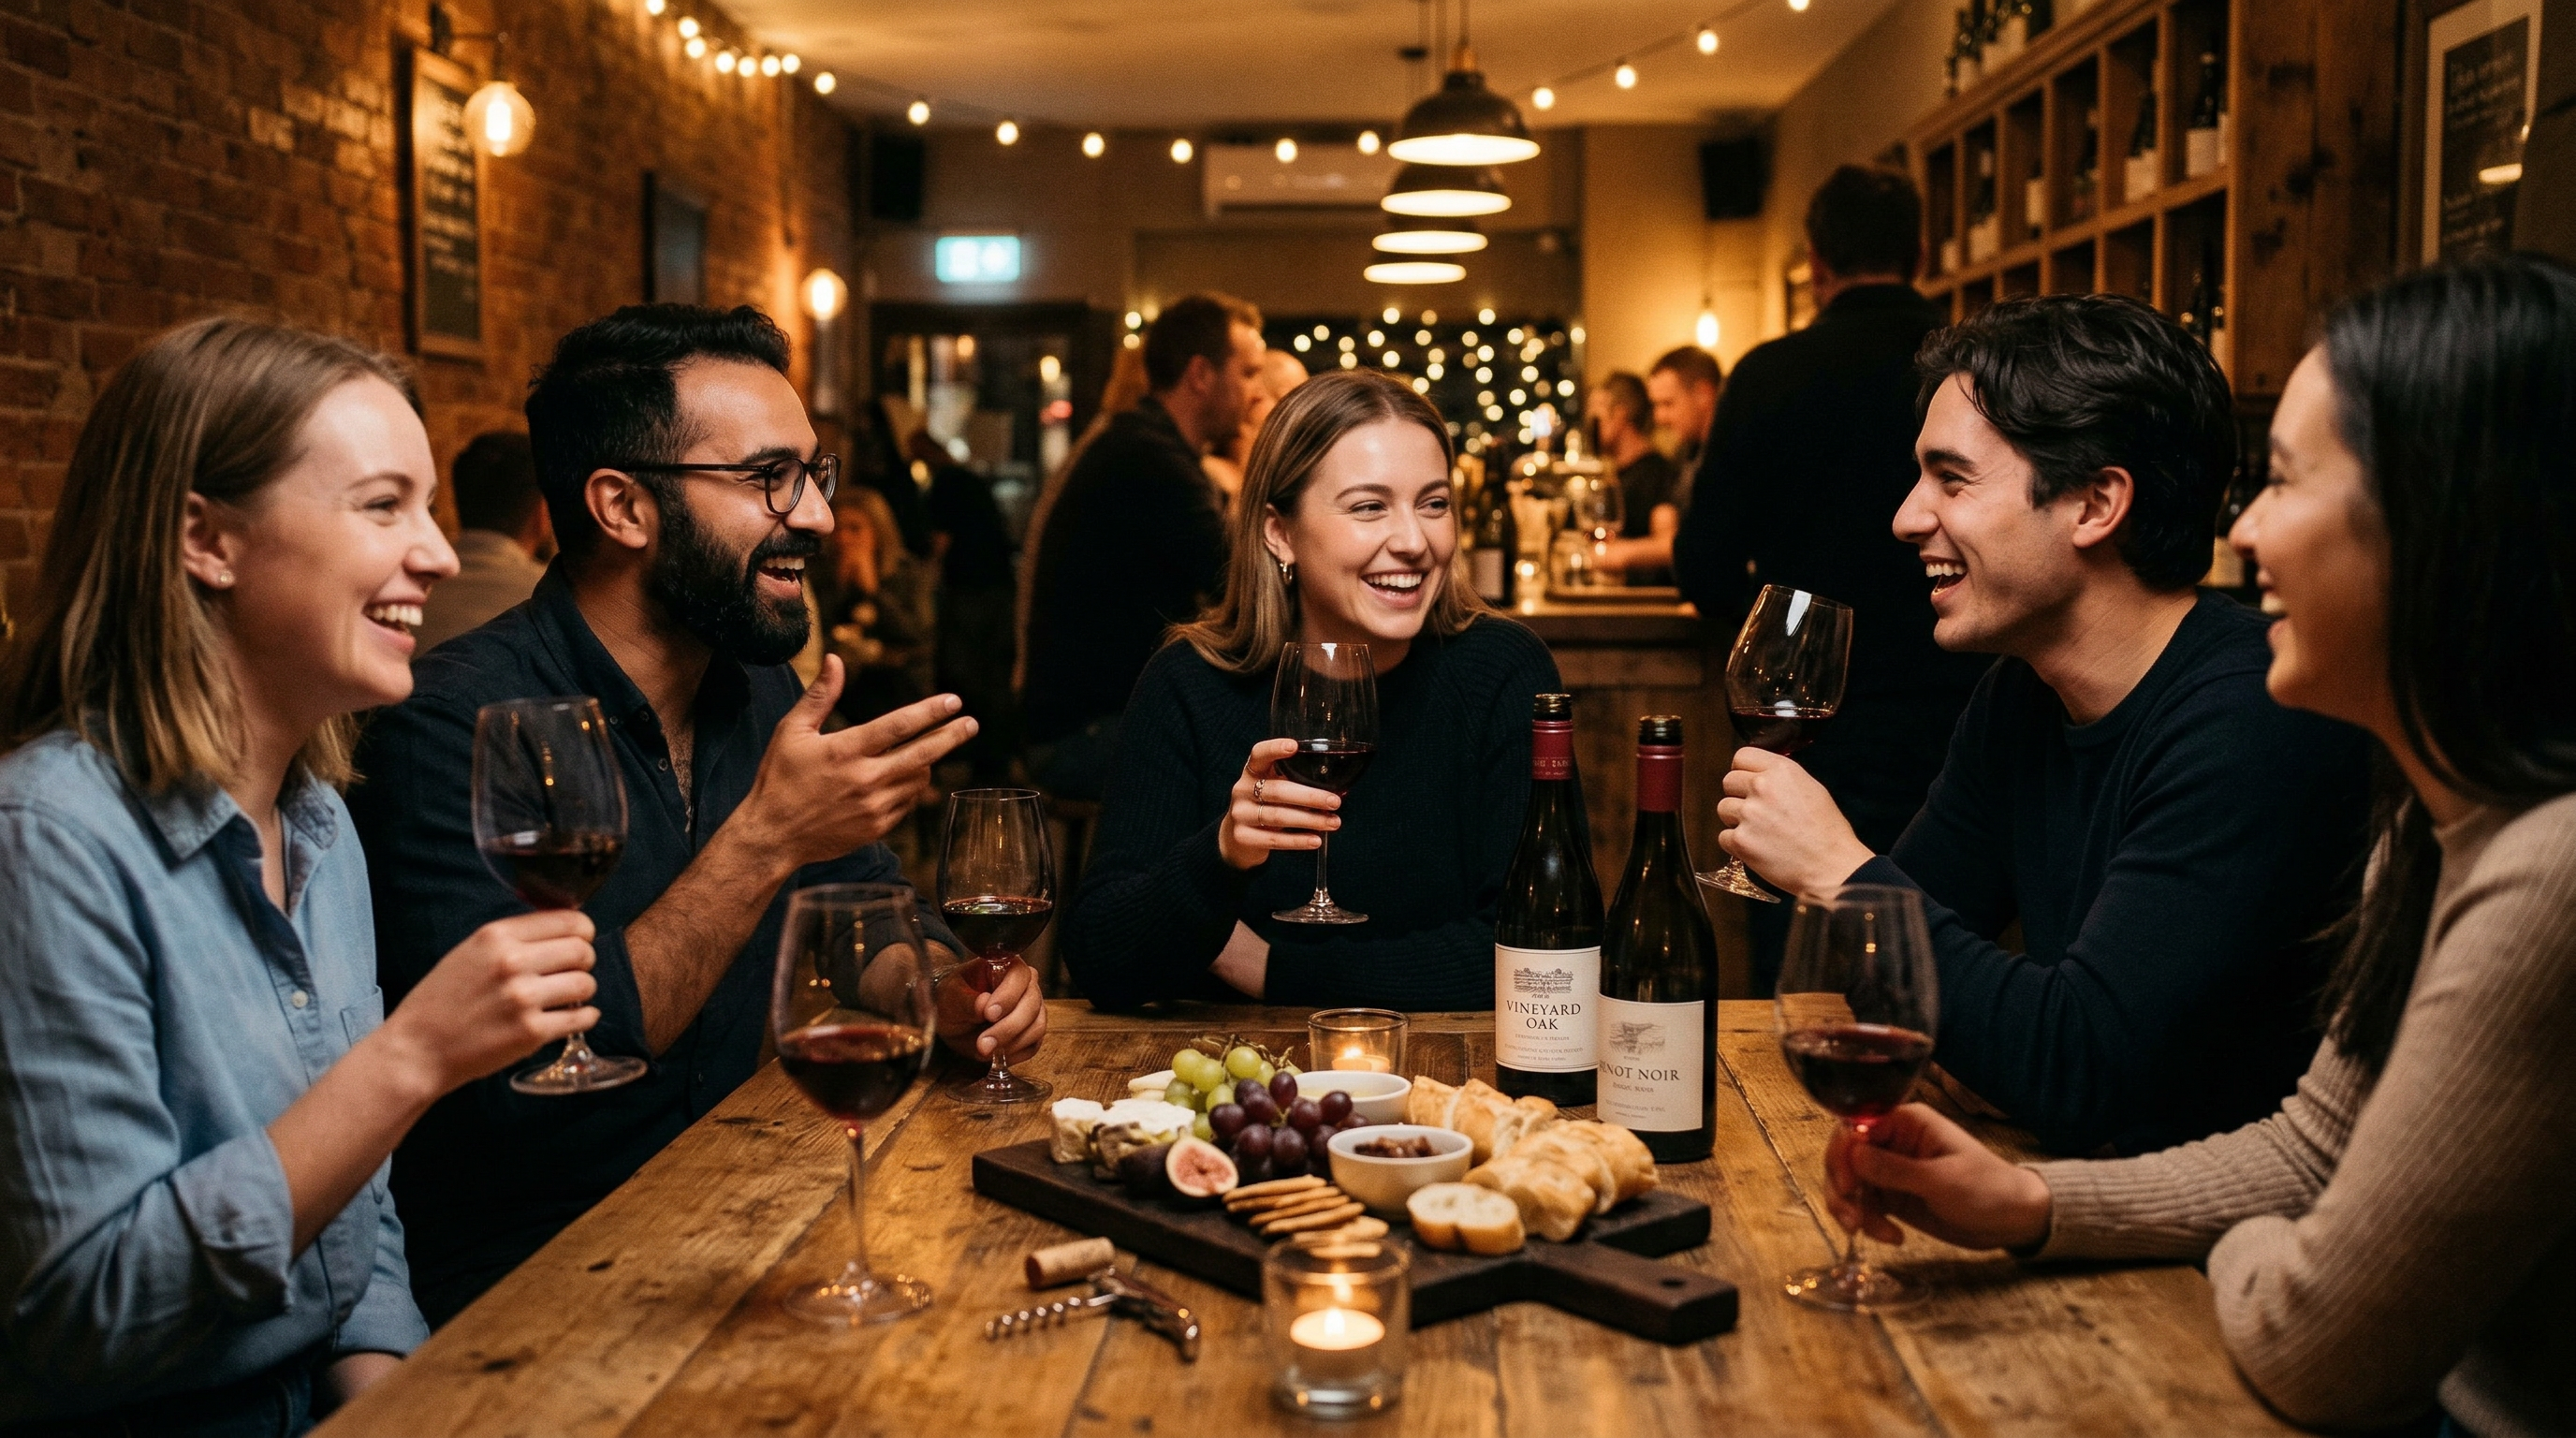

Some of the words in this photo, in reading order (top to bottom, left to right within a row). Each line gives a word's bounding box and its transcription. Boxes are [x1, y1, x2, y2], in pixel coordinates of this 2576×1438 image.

[1506, 1000, 1581, 1016] VINEYARD
[1526, 1017, 1559, 1030] OAK
[1599, 1060, 1632, 1078] NOT
[1638, 1068, 1680, 1081] NOIR
